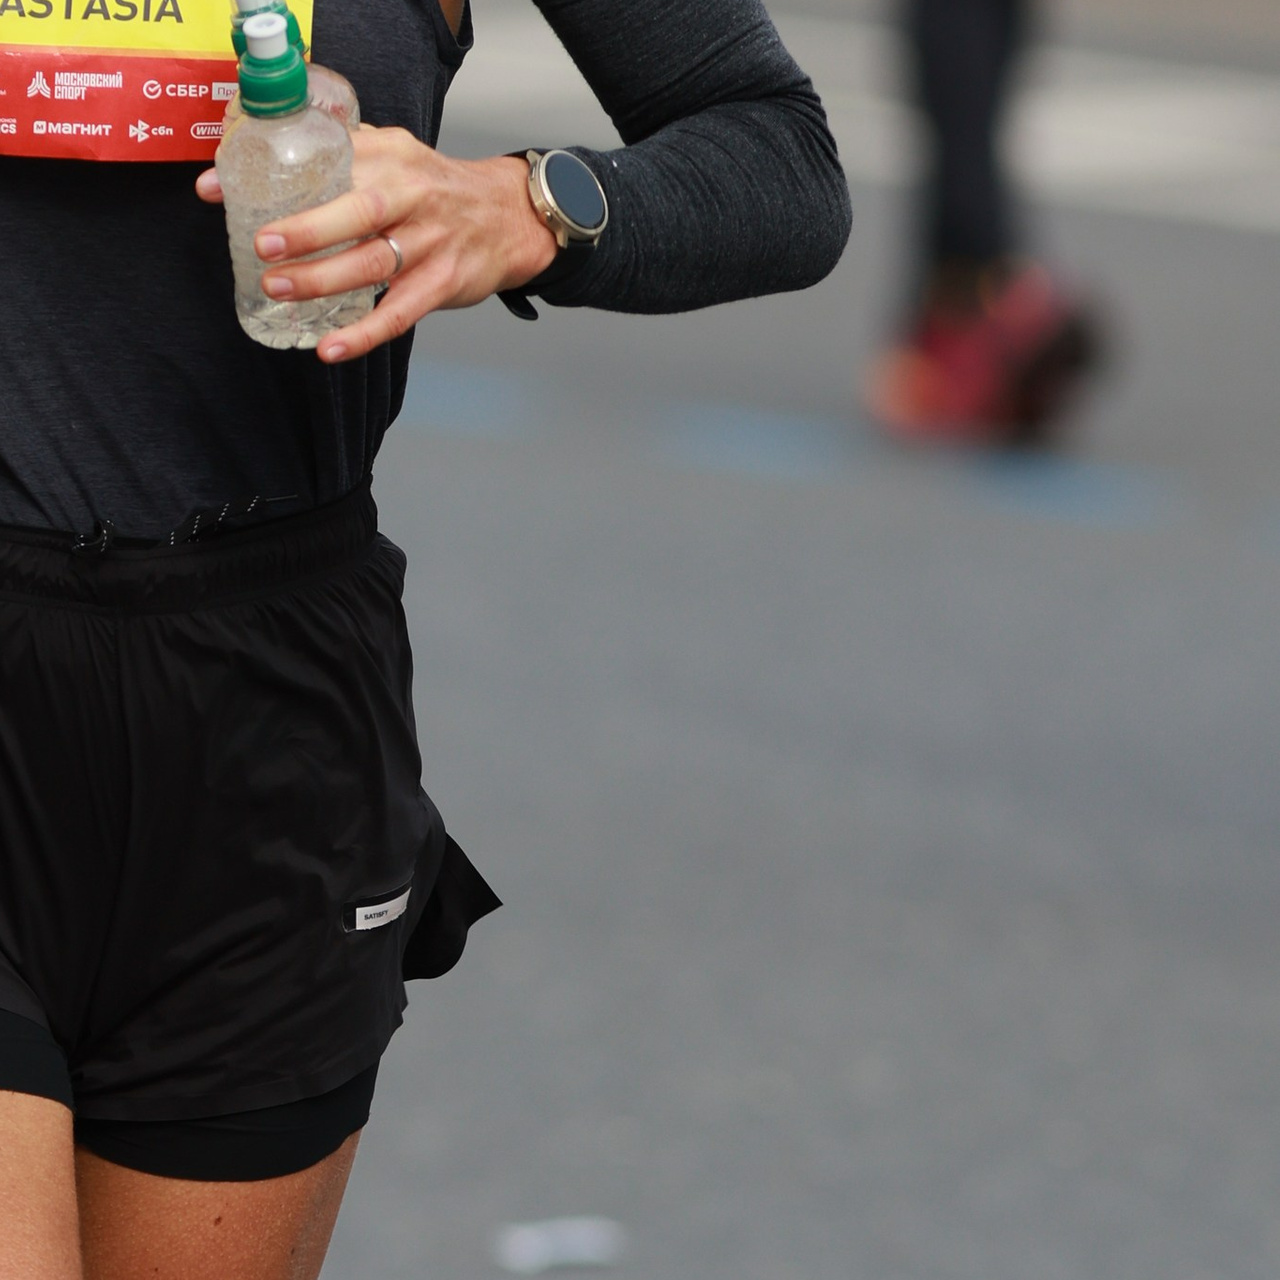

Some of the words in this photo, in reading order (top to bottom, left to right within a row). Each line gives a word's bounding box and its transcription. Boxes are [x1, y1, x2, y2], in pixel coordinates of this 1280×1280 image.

[54, 71, 122, 88] МОСКОВСКИЙ
[54, 86, 87, 100] СПОРТ
[165, 83, 209, 97] СБЕР
[217, 87, 237, 97] Пра
[195, 125, 223, 136] WINL
[364, 909, 389, 921] SATISFY
